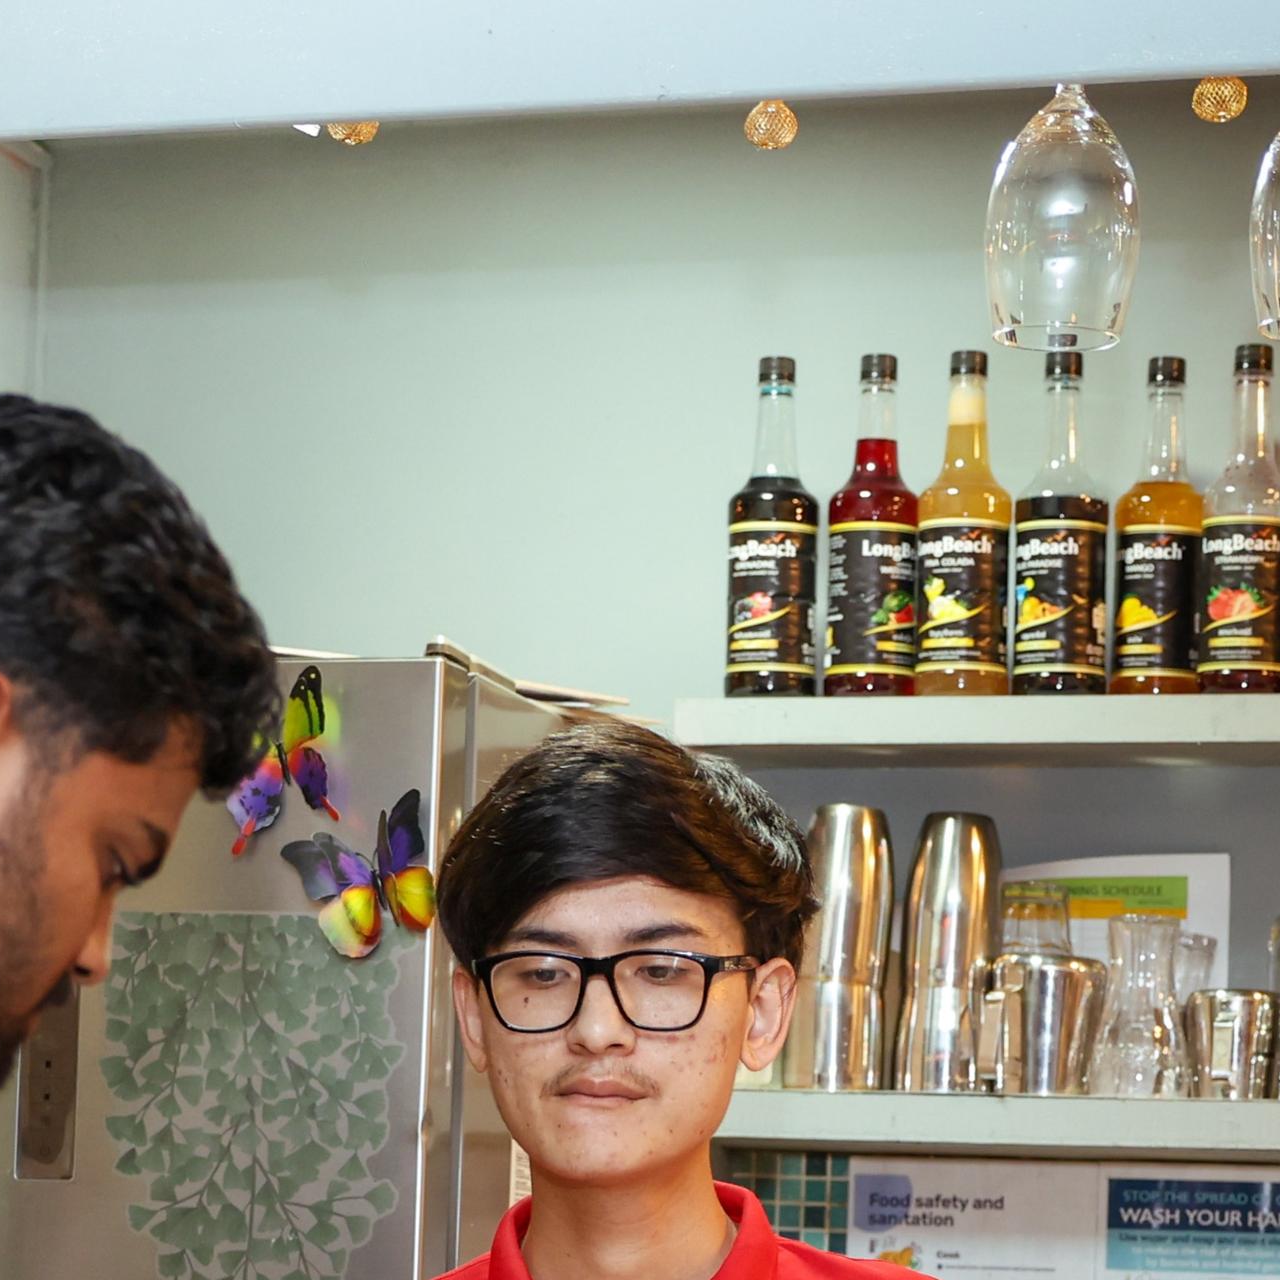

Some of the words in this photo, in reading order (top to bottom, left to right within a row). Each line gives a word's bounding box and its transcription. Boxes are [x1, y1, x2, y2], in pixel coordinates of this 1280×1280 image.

[1101, 884, 1163, 896] SCHEDULE
[869, 1192, 911, 1209] Food
[915, 1193, 969, 1212] safety
[972, 1196, 1005, 1211] and
[1123, 1189, 1160, 1202] STOP
[1165, 1191, 1190, 1204] THE
[1194, 1191, 1248, 1206] SPREAD
[868, 1212, 955, 1228] sanitation
[1120, 1207, 1180, 1226] WASH
[1185, 1209, 1243, 1227] YOUR
